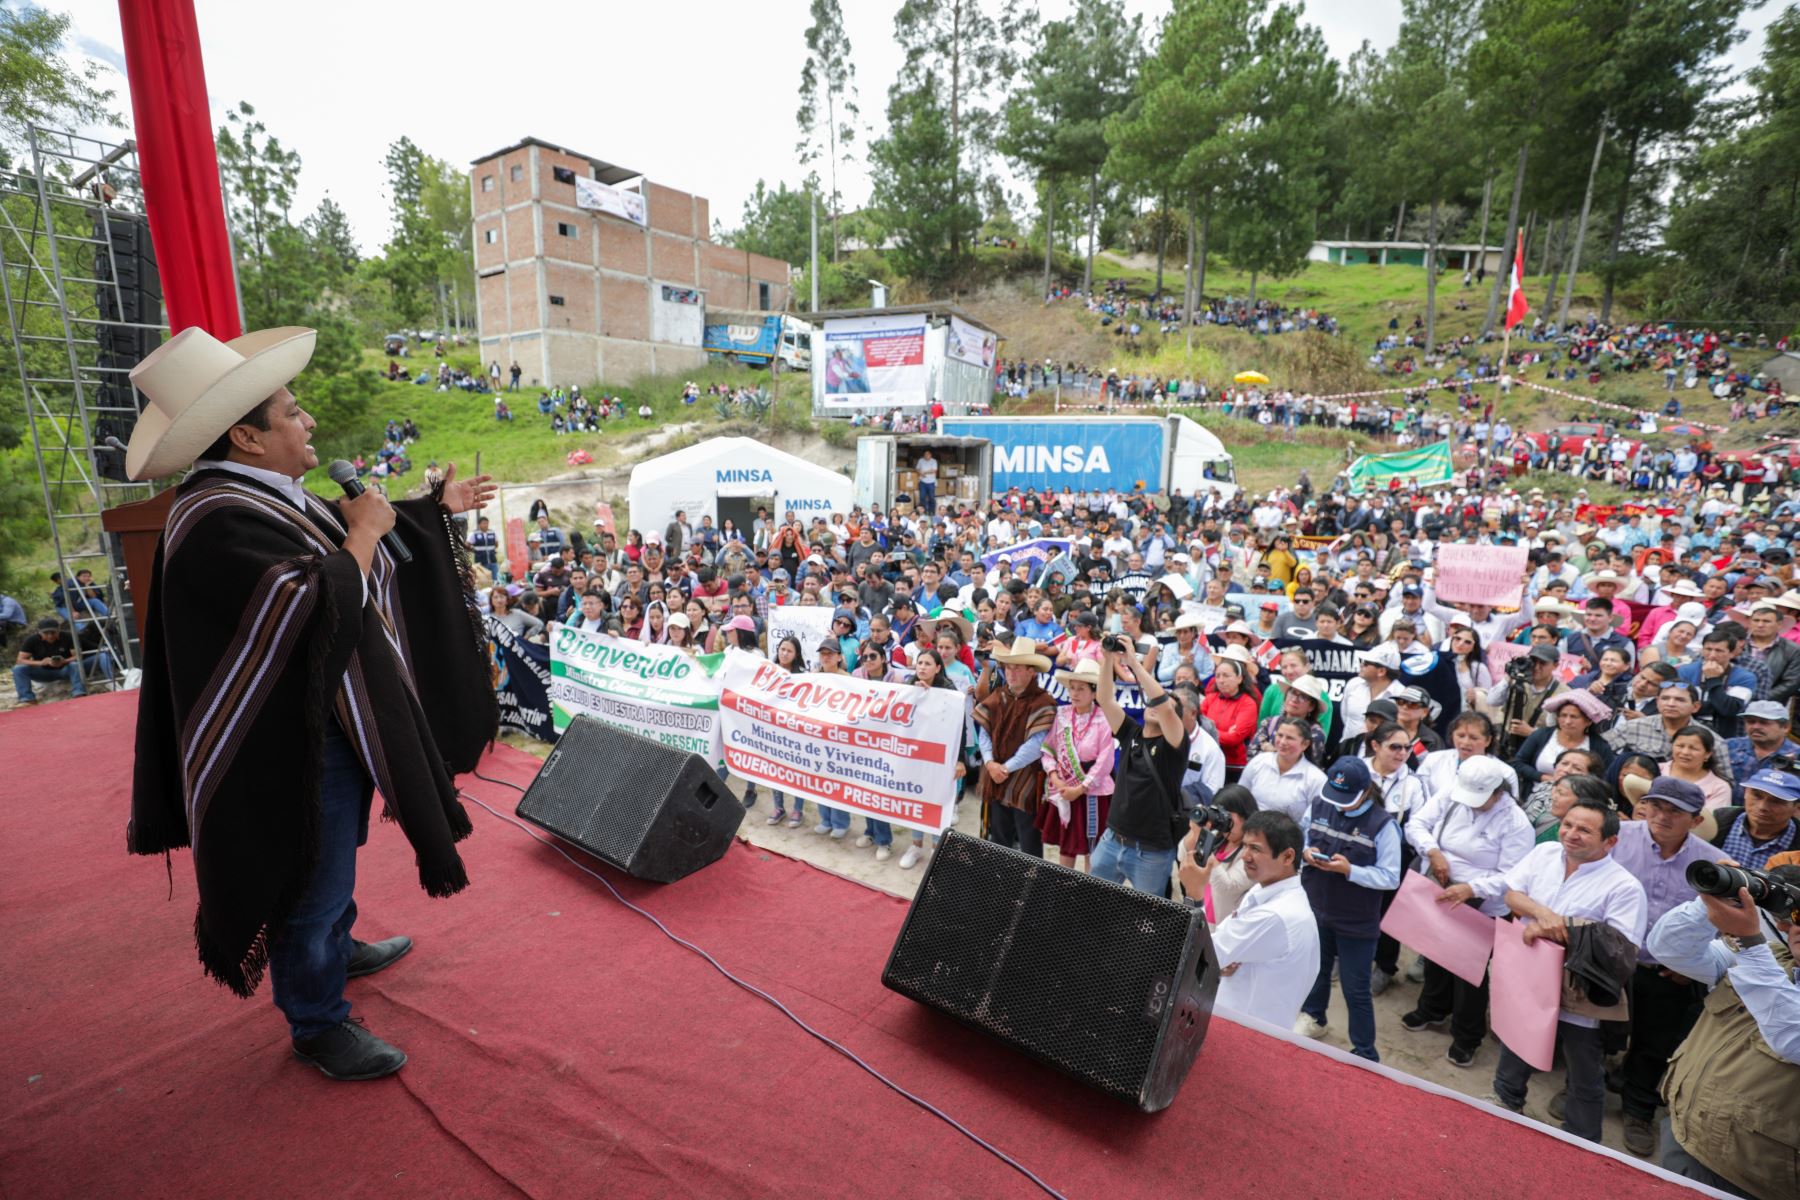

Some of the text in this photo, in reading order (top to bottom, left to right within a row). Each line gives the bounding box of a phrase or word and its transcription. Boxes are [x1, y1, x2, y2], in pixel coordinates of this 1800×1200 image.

[716, 469, 773, 483] MINSA
[993, 445, 1111, 473] MINSA
[785, 499, 832, 511] MINSA
[556, 628, 691, 680] Bienvenido
[562, 685, 590, 707] SALUD
[590, 693, 601, 711] ES
[601, 696, 646, 722] NUESTRA
[646, 707, 712, 733] PRIORIDAD
[751, 661, 915, 726] Bienvenida
[659, 731, 710, 755] PRESENTE
[735, 696, 919, 757] Hania Pérez de Cuellar
[751, 723, 895, 777] Ministra de Vivienda,
[731, 729, 924, 794] Construcción y Sanemaiento
[843, 785, 923, 819] PRESENTE
